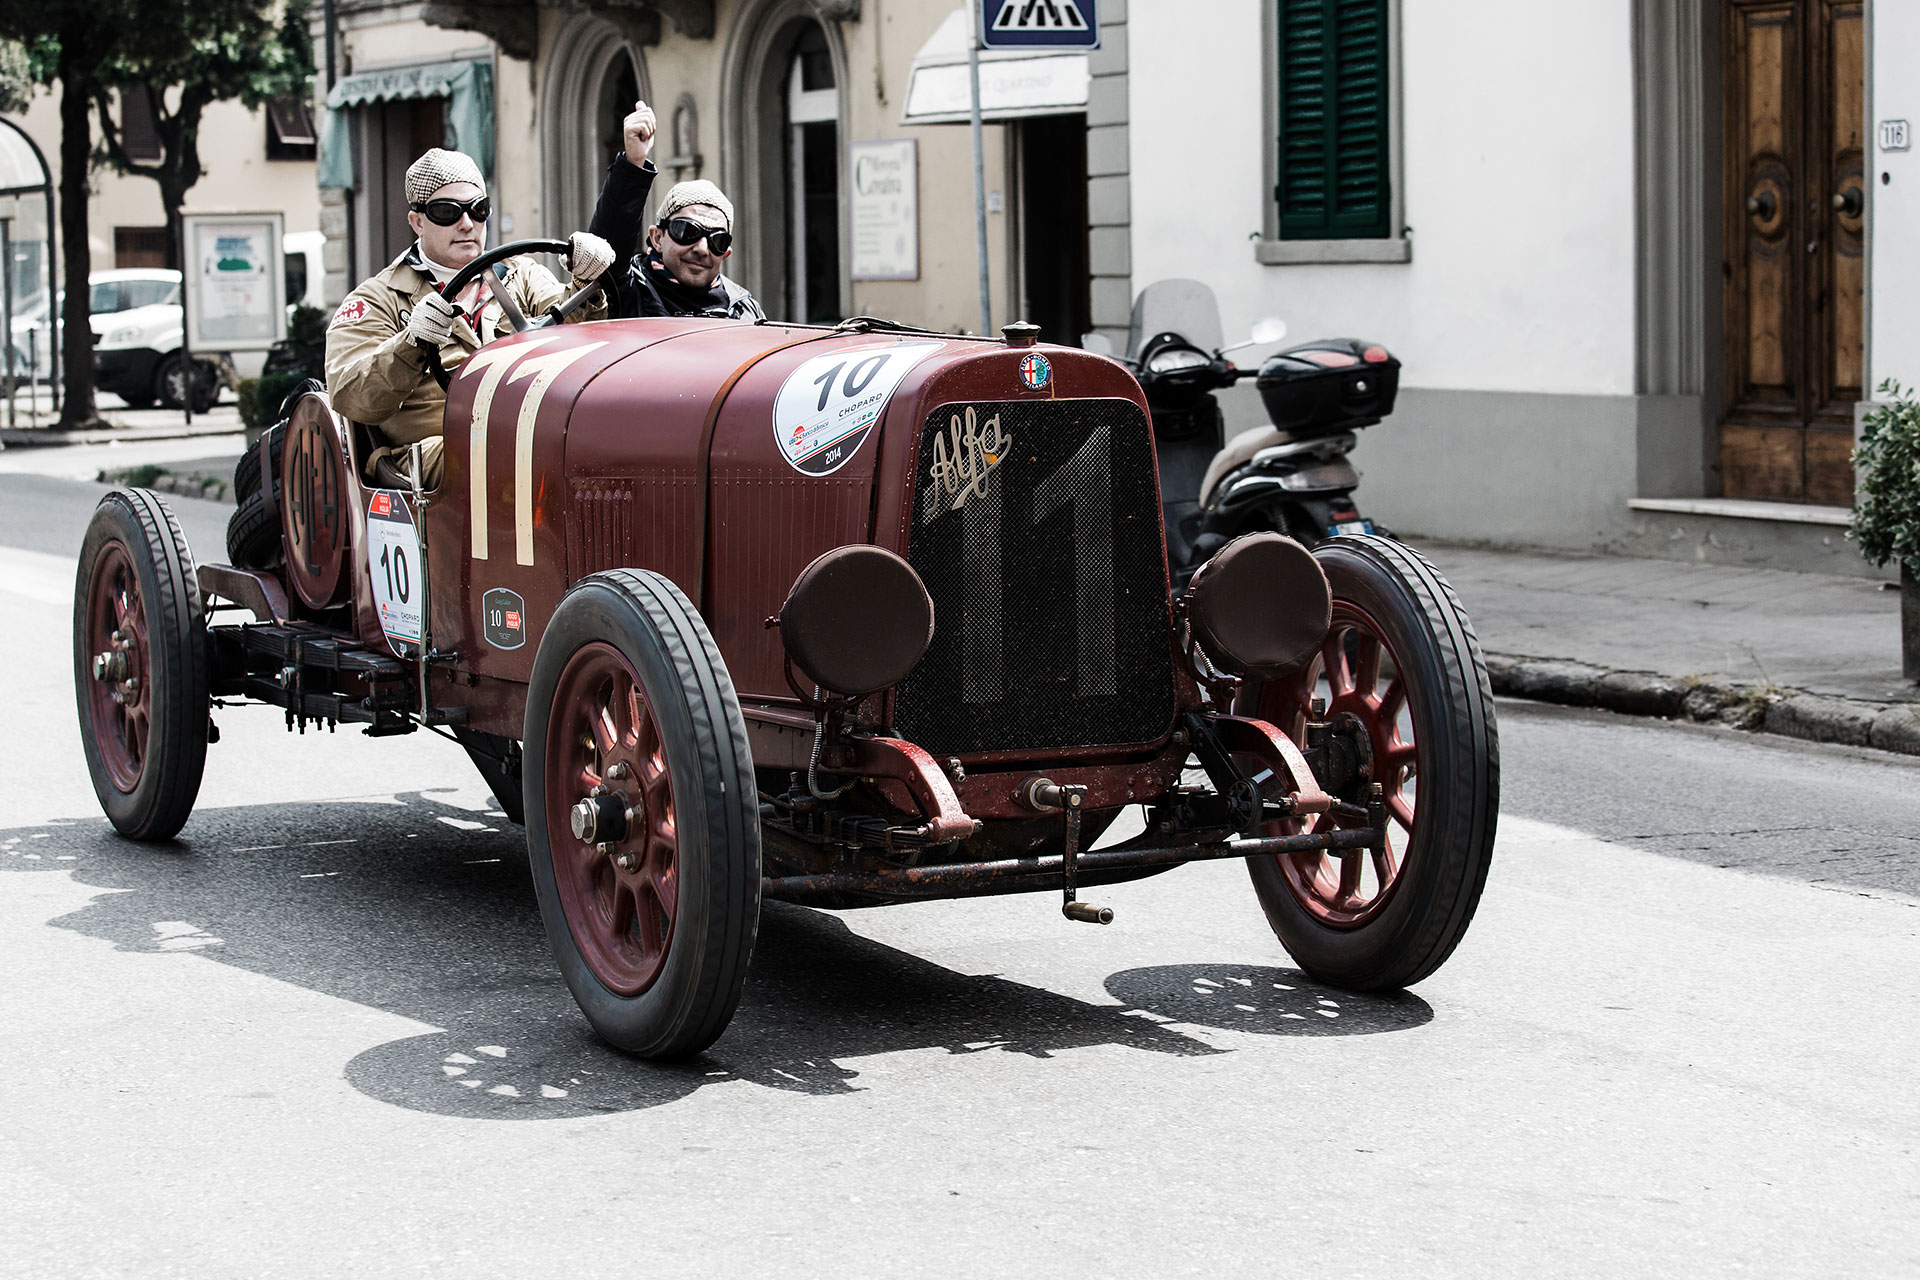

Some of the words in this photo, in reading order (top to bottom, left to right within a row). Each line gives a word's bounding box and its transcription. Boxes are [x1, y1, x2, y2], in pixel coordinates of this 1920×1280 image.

[1885, 126, 1903, 144] 116
[813, 354, 892, 413] 10
[838, 392, 883, 418] CHOPARD
[459, 336, 609, 566] 11
[825, 446, 842, 465] 2014
[926, 406, 1012, 515] Alfa
[380, 544, 409, 604] 10
[490, 609, 502, 627] 10
